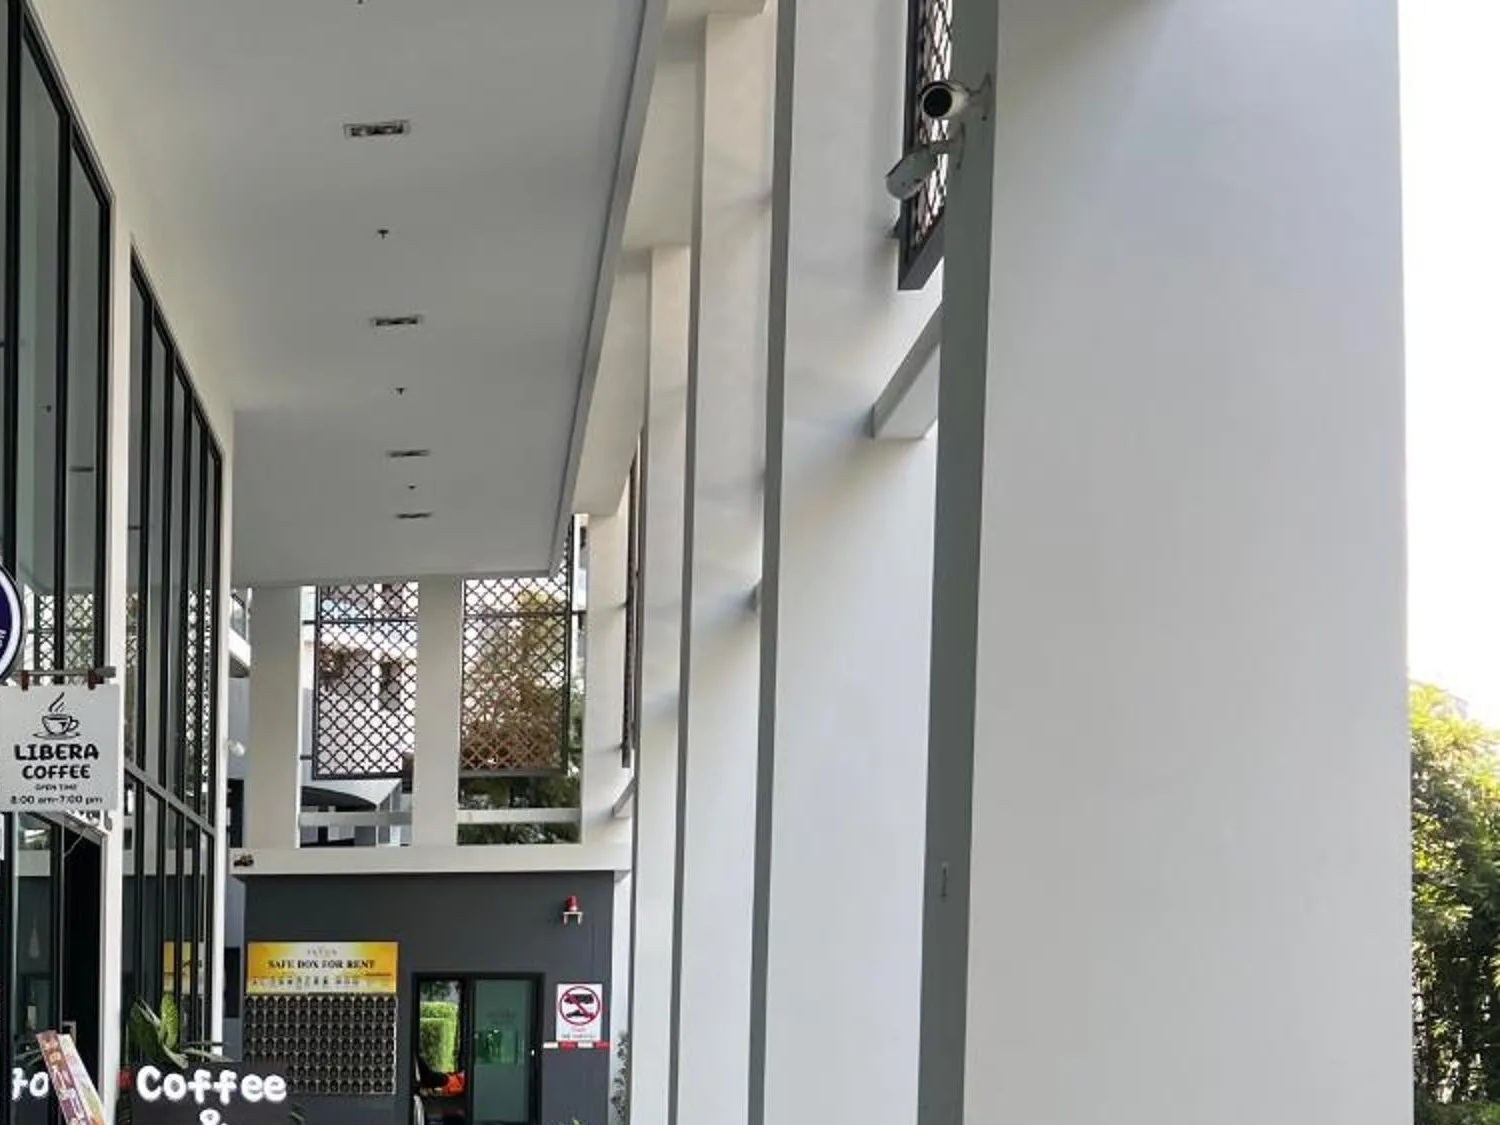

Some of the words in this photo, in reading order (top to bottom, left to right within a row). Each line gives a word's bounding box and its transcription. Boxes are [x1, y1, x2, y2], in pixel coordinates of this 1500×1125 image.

[14, 744, 100, 761] LIBERA
[22, 764, 91, 779] COFFEE
[11, 795, 35, 804] 8:00
[85, 796, 103, 805] pm
[268, 959, 294, 969] SAFE
[297, 959, 318, 969] BOX
[322, 959, 343, 969] FOR
[347, 959, 376, 969] RENT
[136, 1065, 287, 1105] Coffee
